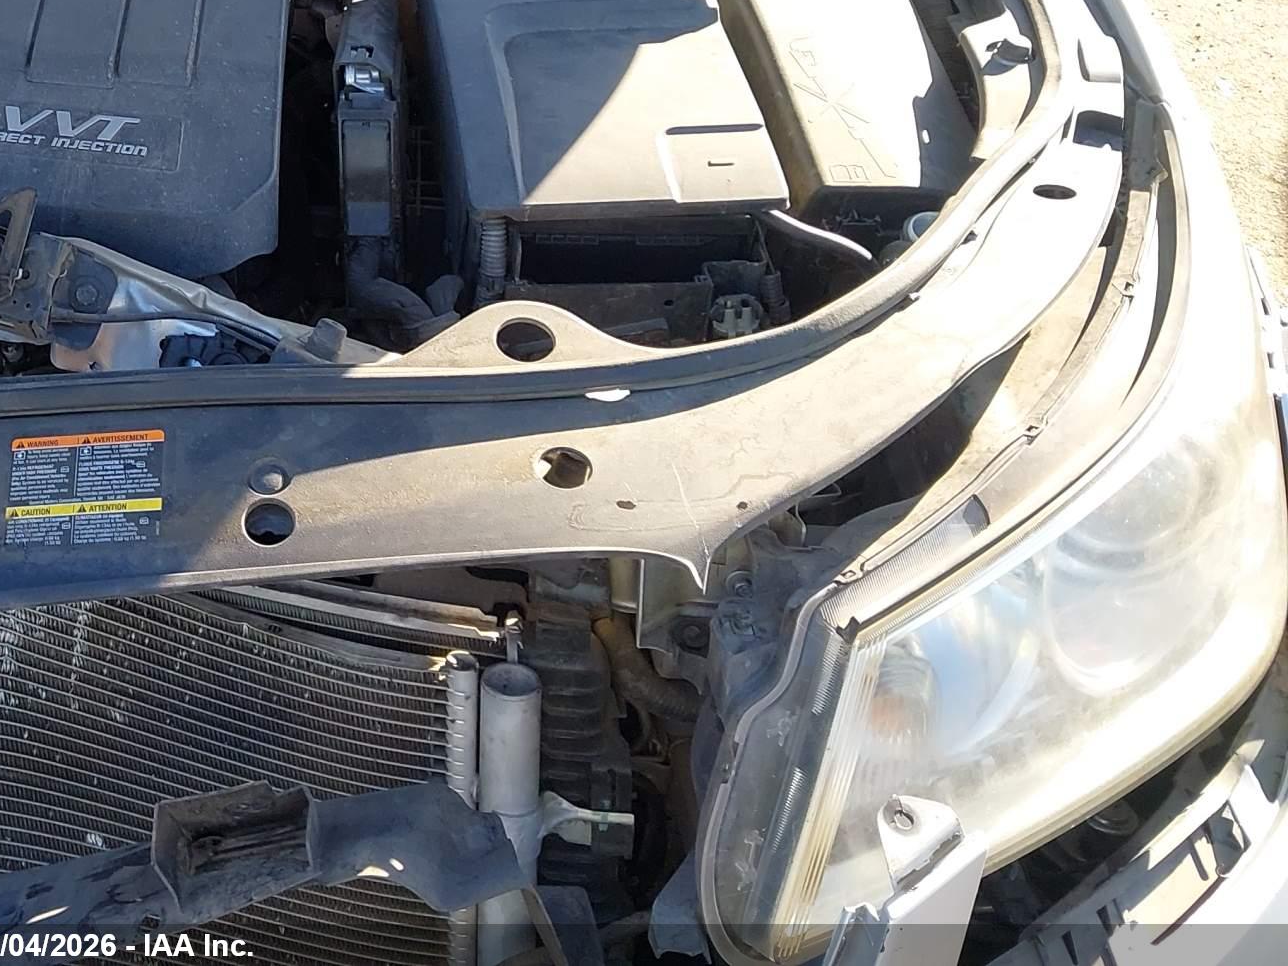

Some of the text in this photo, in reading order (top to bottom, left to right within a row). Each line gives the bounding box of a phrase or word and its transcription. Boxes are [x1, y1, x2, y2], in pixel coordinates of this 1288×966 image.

[5, 105, 141, 141] VVT
[51, 137, 148, 157] INJECTION
[27, 433, 149, 448] WARNING AVERTISSEMENT
[21, 502, 128, 516] CAUTION ATTENTION
